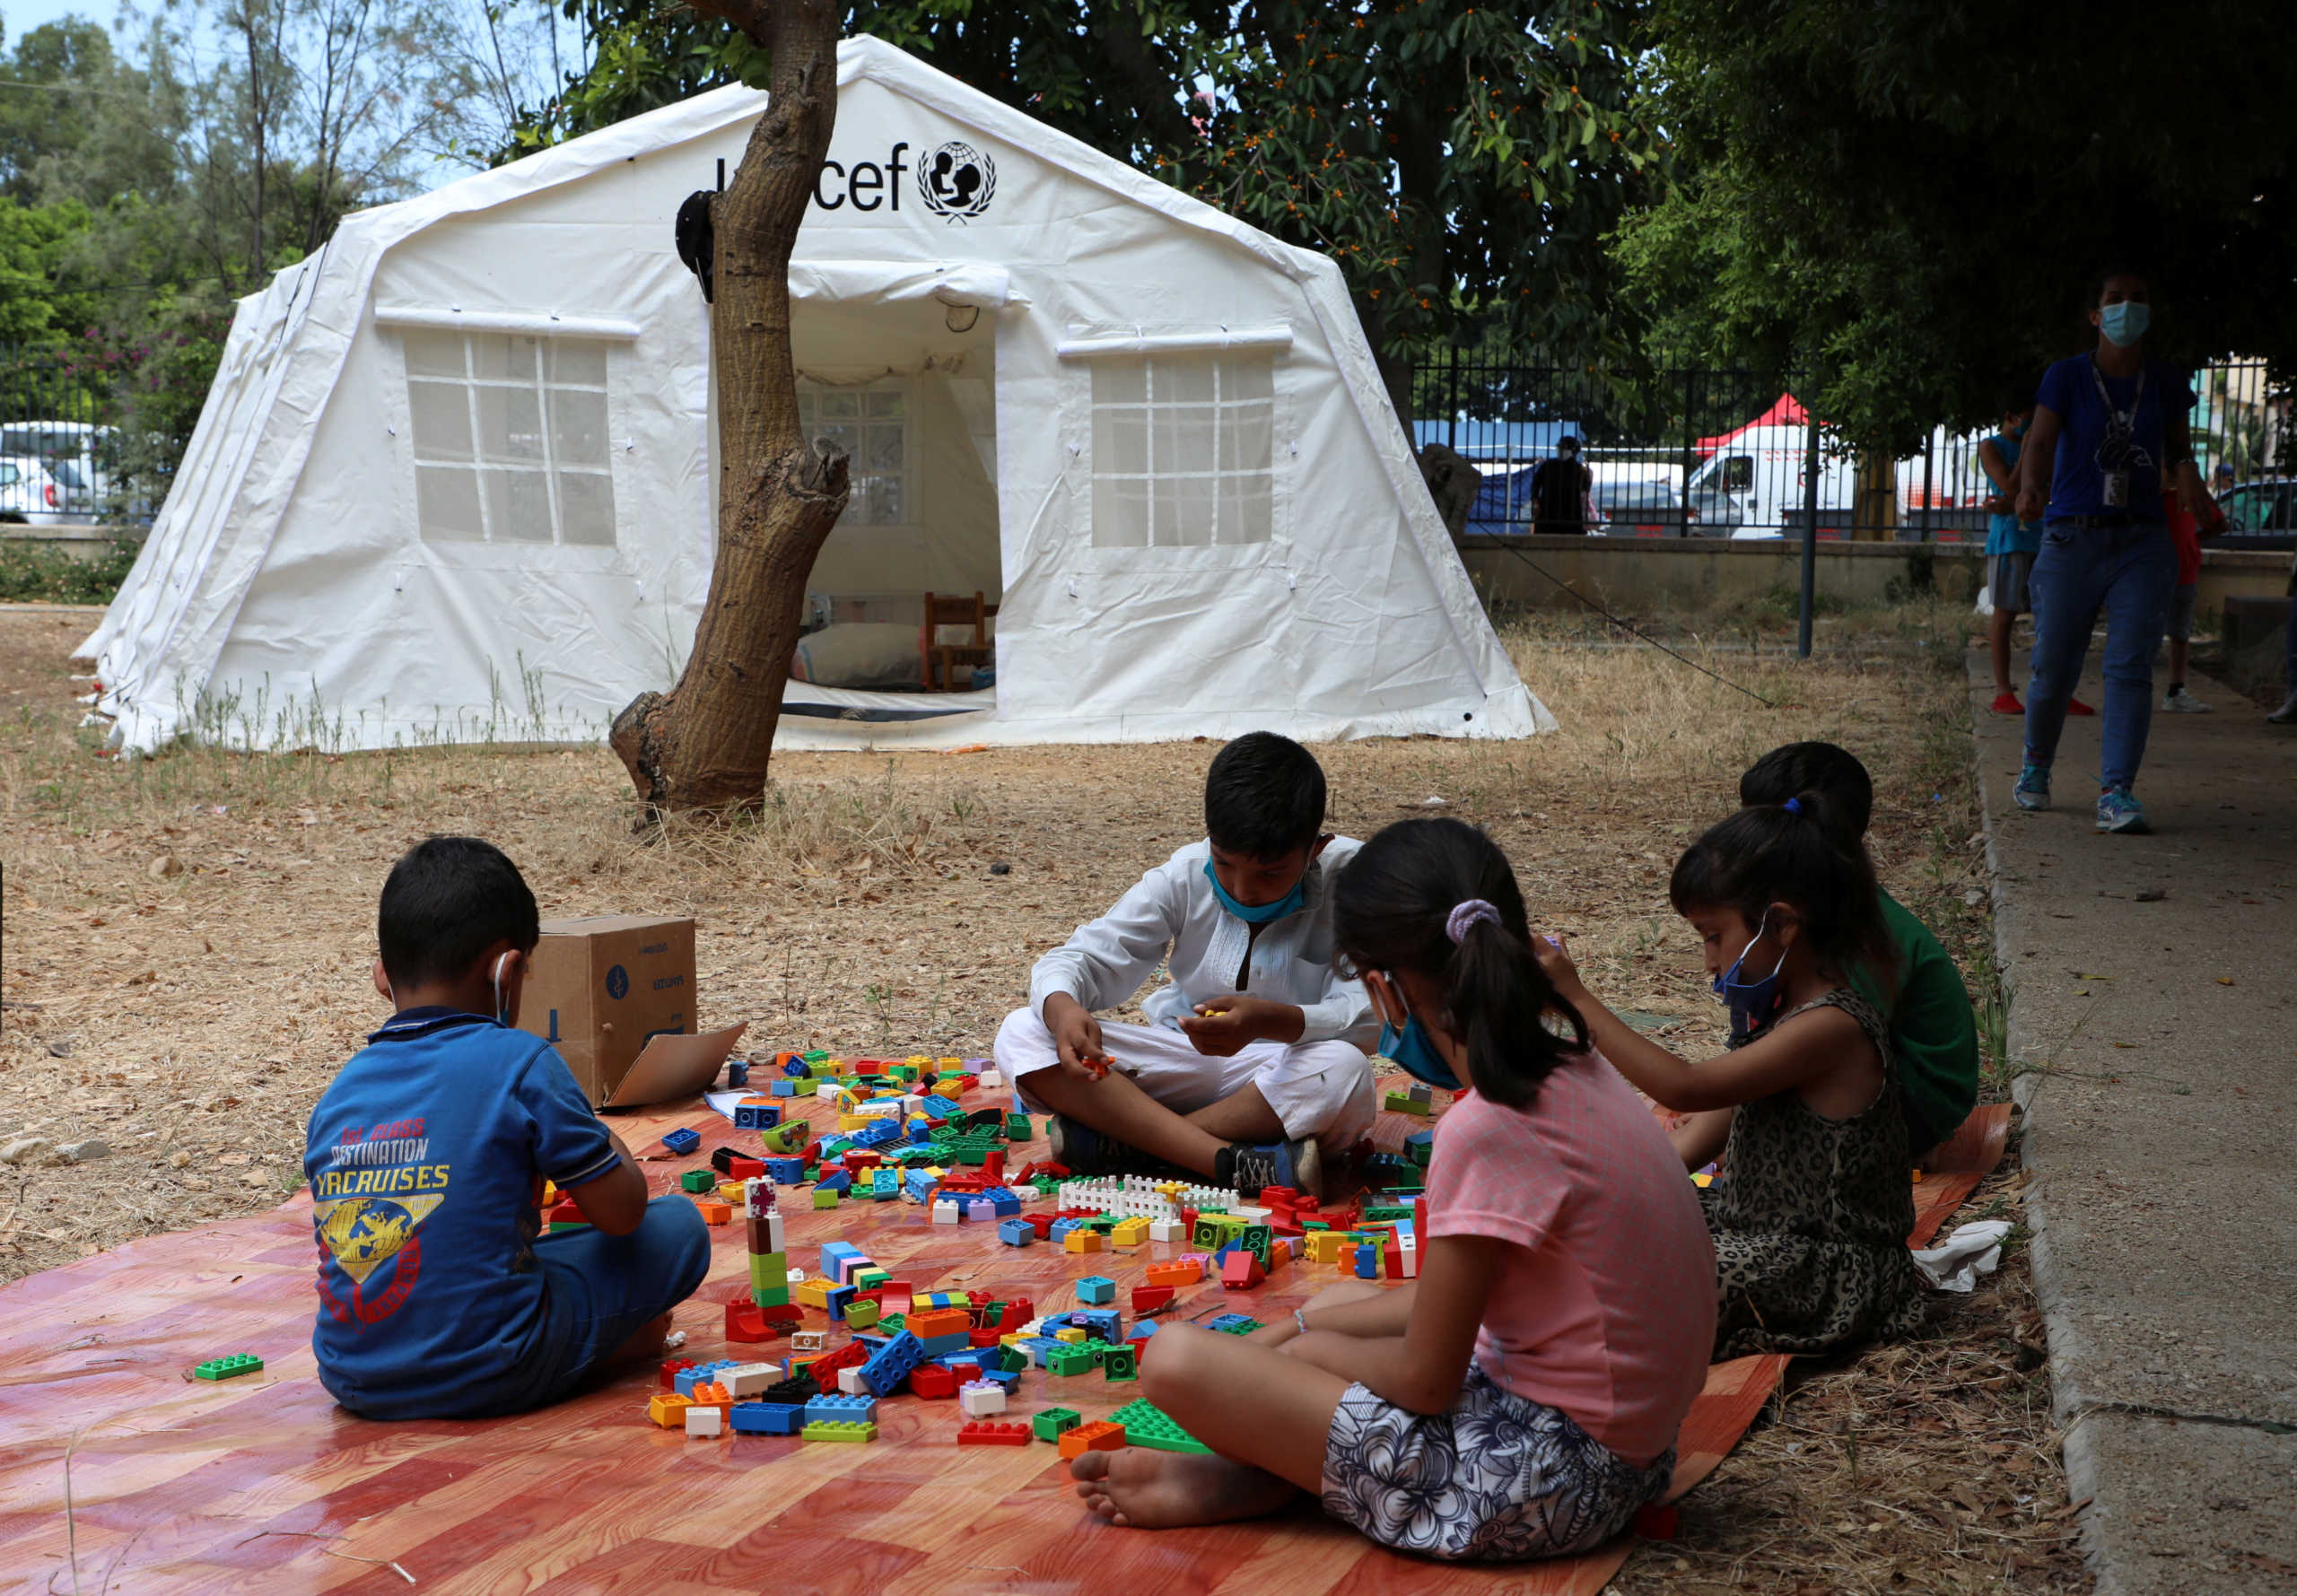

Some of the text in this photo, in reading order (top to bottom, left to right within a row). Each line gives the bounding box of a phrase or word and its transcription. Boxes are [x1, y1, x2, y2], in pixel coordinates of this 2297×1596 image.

[717, 142, 909, 212] cef
[370, 1118, 426, 1141] CLASS
[329, 1138, 430, 1166] DESTINATION
